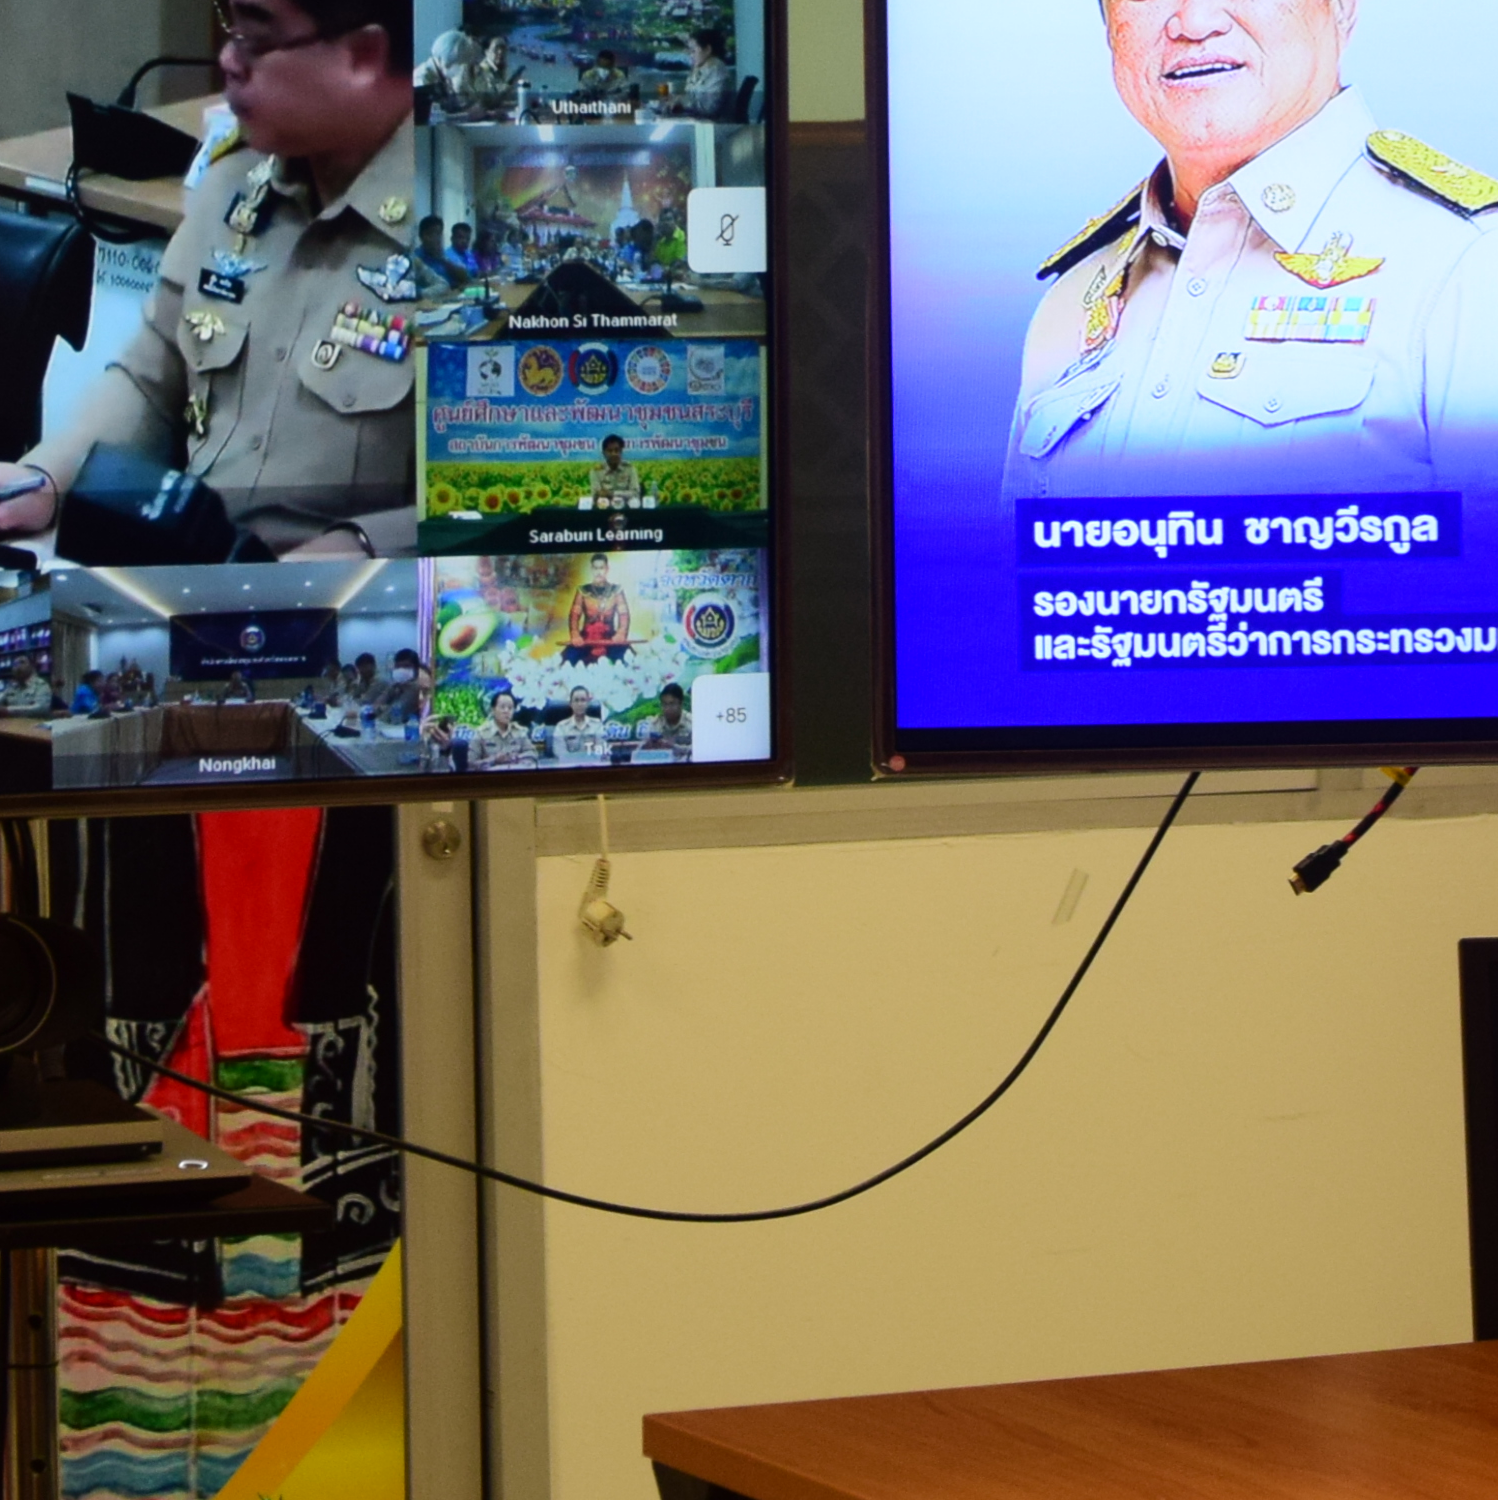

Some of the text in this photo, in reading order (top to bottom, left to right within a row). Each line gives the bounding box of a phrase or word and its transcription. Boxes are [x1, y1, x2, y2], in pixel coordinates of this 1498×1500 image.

[551, 100, 632, 116] Uthaithani
[509, 313, 678, 330] Nakhon Si Thammarat
[529, 525, 664, 545] Saraburi Learning
[1033, 505, 1439, 558] นายอนุทิน ชาญวีรกูล
[1033, 576, 1324, 622] รองนายกรัฐมนตรี
[715, 706, 747, 724] +85
[584, 741, 613, 758] Tak
[199, 756, 276, 775] Nongkhai
